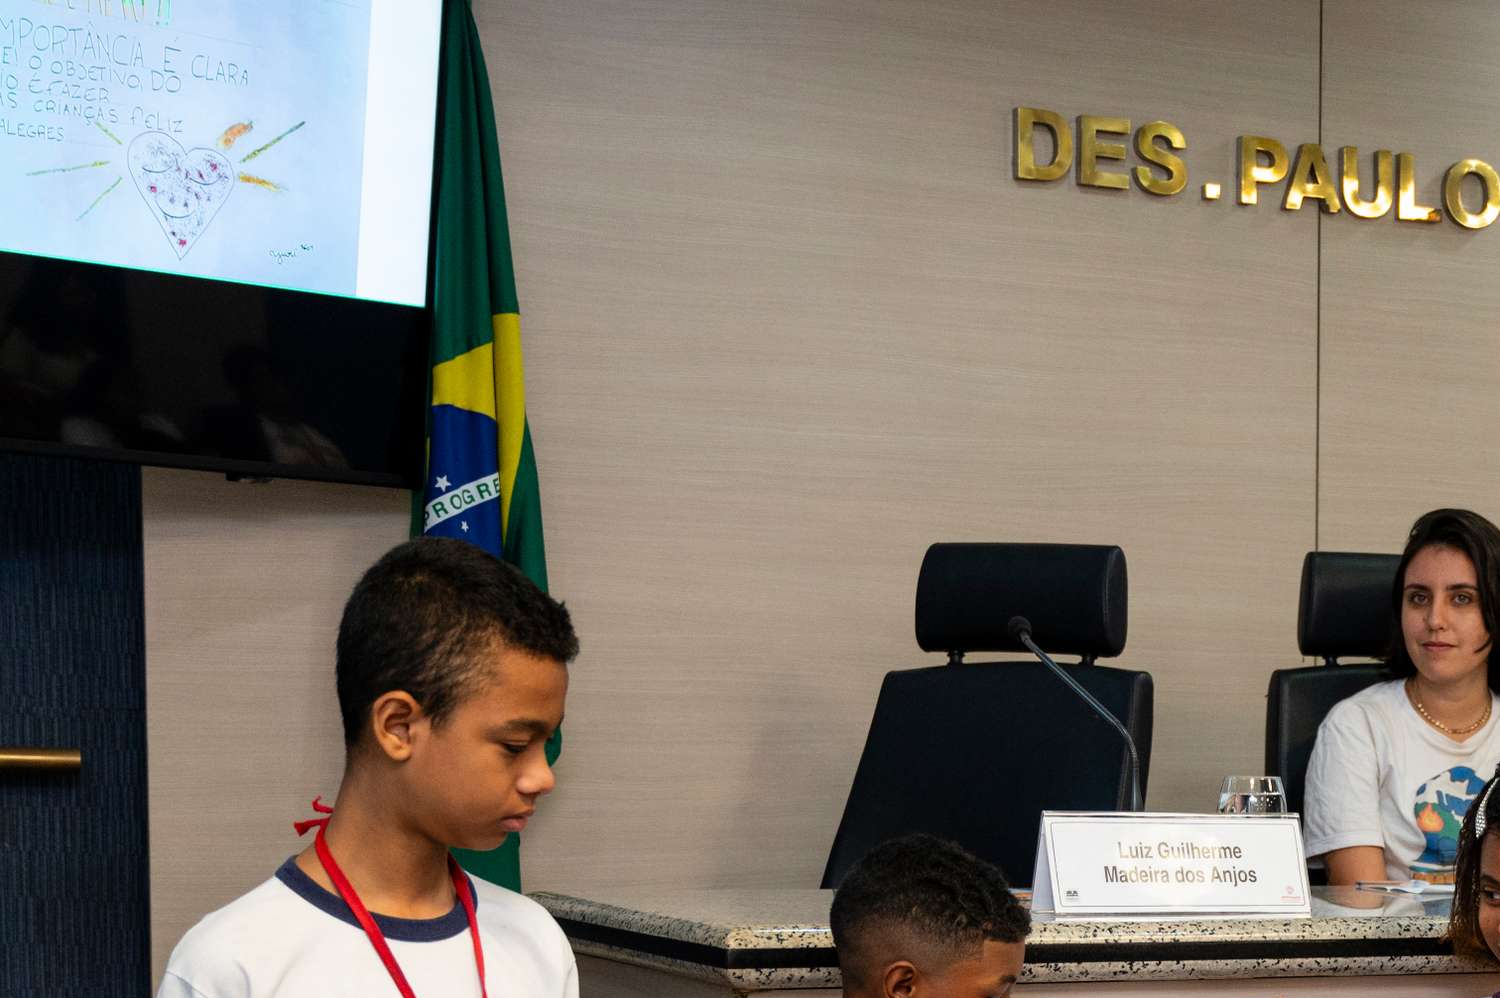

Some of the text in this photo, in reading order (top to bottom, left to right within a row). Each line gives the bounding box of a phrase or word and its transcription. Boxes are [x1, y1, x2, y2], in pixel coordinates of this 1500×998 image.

[29, 55, 42, 70] O
[151, 70, 181, 93] DO
[191, 54, 249, 86] CLARA
[47, 80, 109, 103] FAZER
[33, 99, 119, 126] CRIANÇAS
[1118, 841, 1242, 860] Luiz Guilherme
[1104, 866, 1257, 887] Madeira dos Anjos
